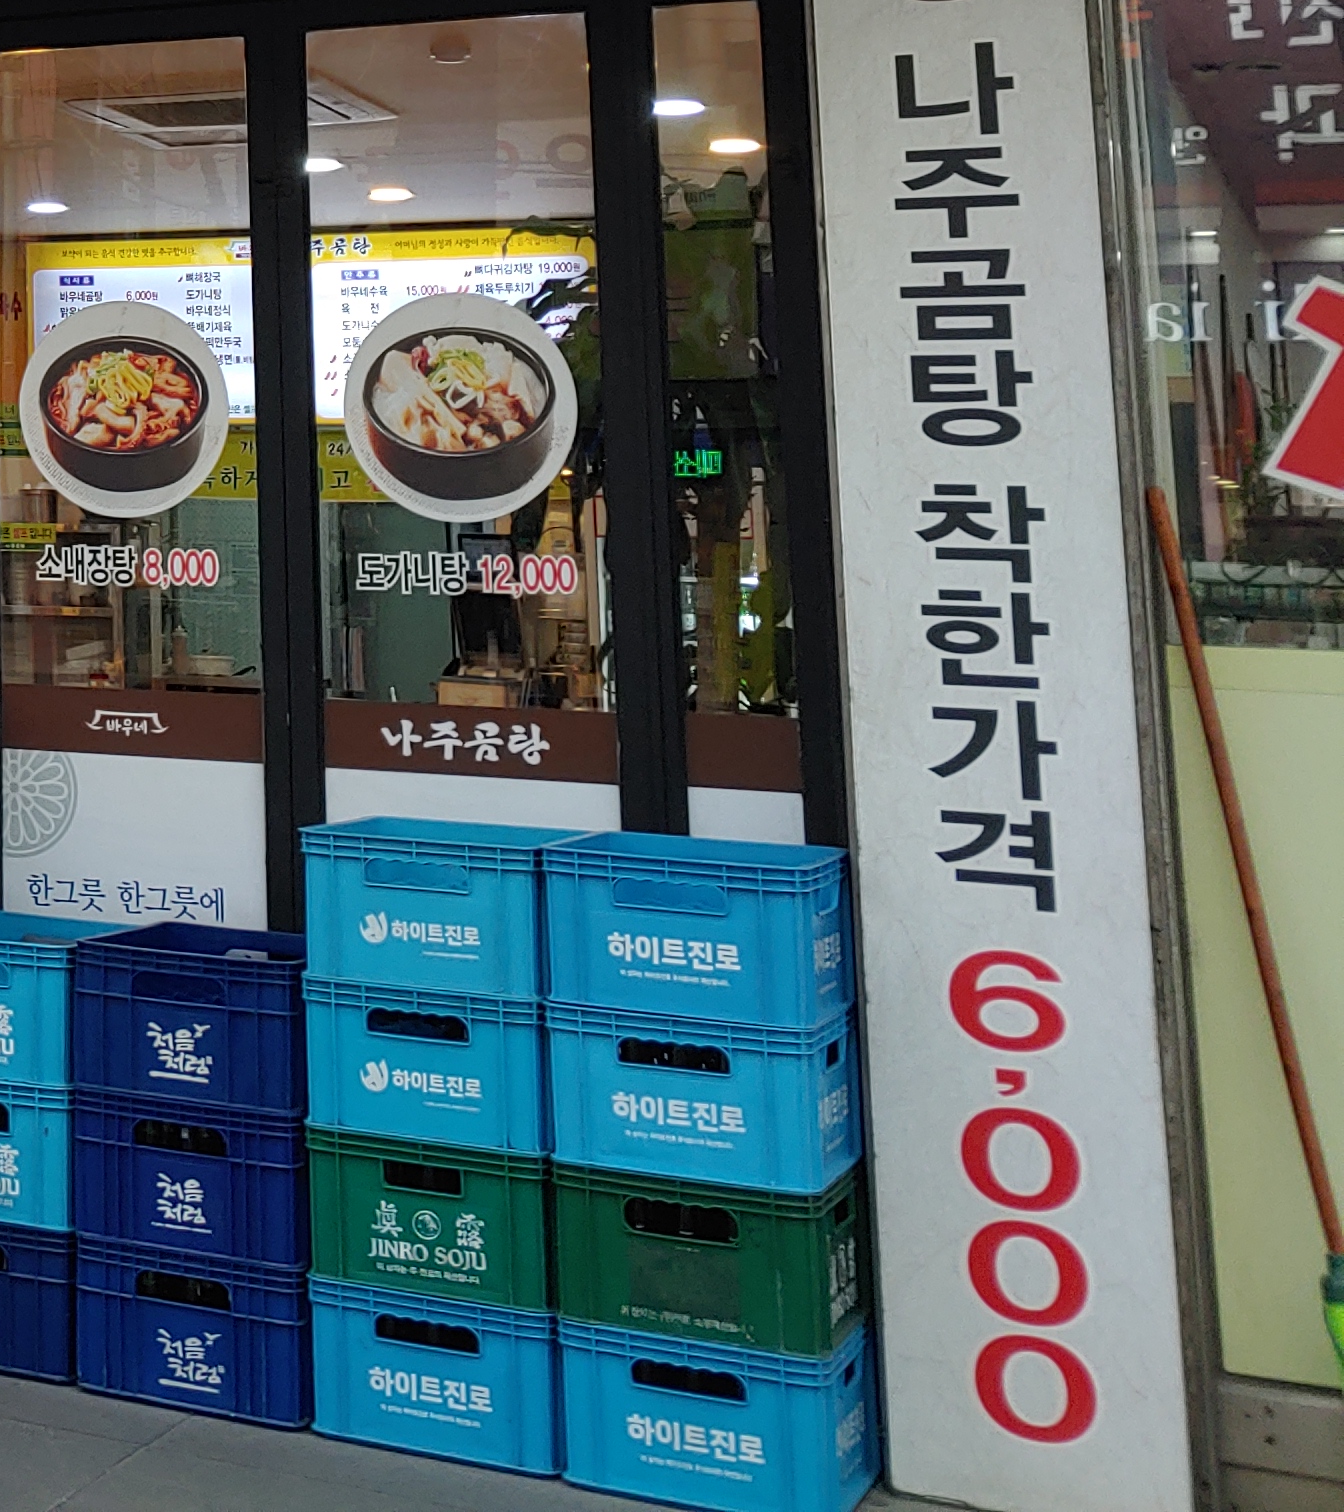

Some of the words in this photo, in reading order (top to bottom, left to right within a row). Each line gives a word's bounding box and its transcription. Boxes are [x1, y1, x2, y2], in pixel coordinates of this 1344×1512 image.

[891, 39, 1036, 450] 나주곰탕
[36, 544, 137, 587] 소내장탕
[142, 547, 220, 589] 8,000
[356, 550, 467, 595] 도가니탕
[479, 554, 578, 598] 12,000
[913, 483, 1060, 915] 착한가격
[105, 716, 149, 735] 바우네
[379, 721, 551, 766] 나주곰탕
[26, 872, 107, 914] 한그릇
[115, 879, 227, 924] 한그릇에
[390, 919, 481, 947] 하이트진로
[607, 931, 742, 972] 하이트진로
[147, 1021, 196, 1053] 처음
[158, 1049, 208, 1076] 처럼
[391, 1068, 483, 1098] 하이트진로
[611, 1090, 747, 1134] 하이트진로
[156, 1172, 205, 1204] 처음
[947, 948, 1099, 1447] 6,000
[156, 1199, 207, 1227] 처럼
[367, 1236, 430, 1263] JINRO
[433, 1245, 488, 1272] SOJU
[157, 1328, 206, 1360] 처음
[168, 1356, 219, 1385] 처럼
[367, 1365, 494, 1414] 하이트진로
[625, 1412, 768, 1466] 하이트진로
